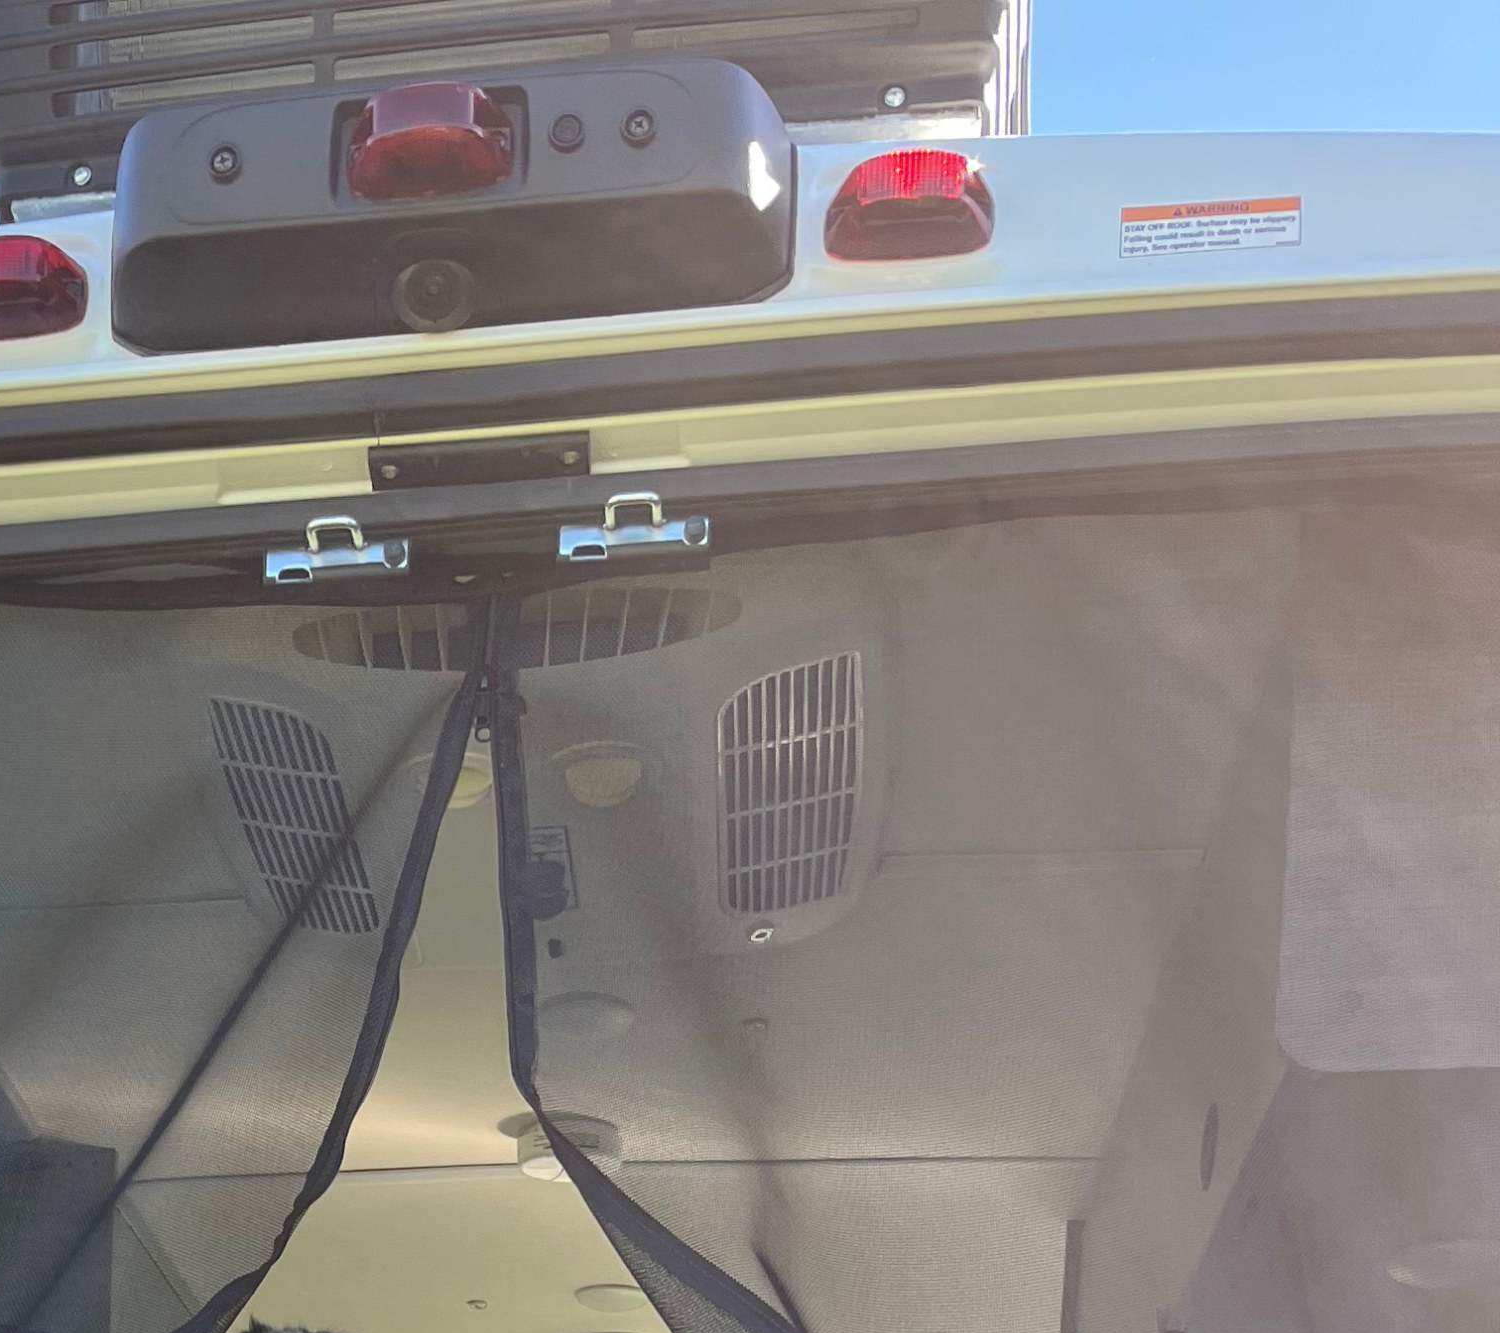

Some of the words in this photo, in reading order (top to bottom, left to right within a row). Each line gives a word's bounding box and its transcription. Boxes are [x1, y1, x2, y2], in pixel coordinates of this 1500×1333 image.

[1185, 201, 1249, 215] WARNING
[1124, 223, 1145, 231] STAY
[1148, 222, 1164, 230] OFF
